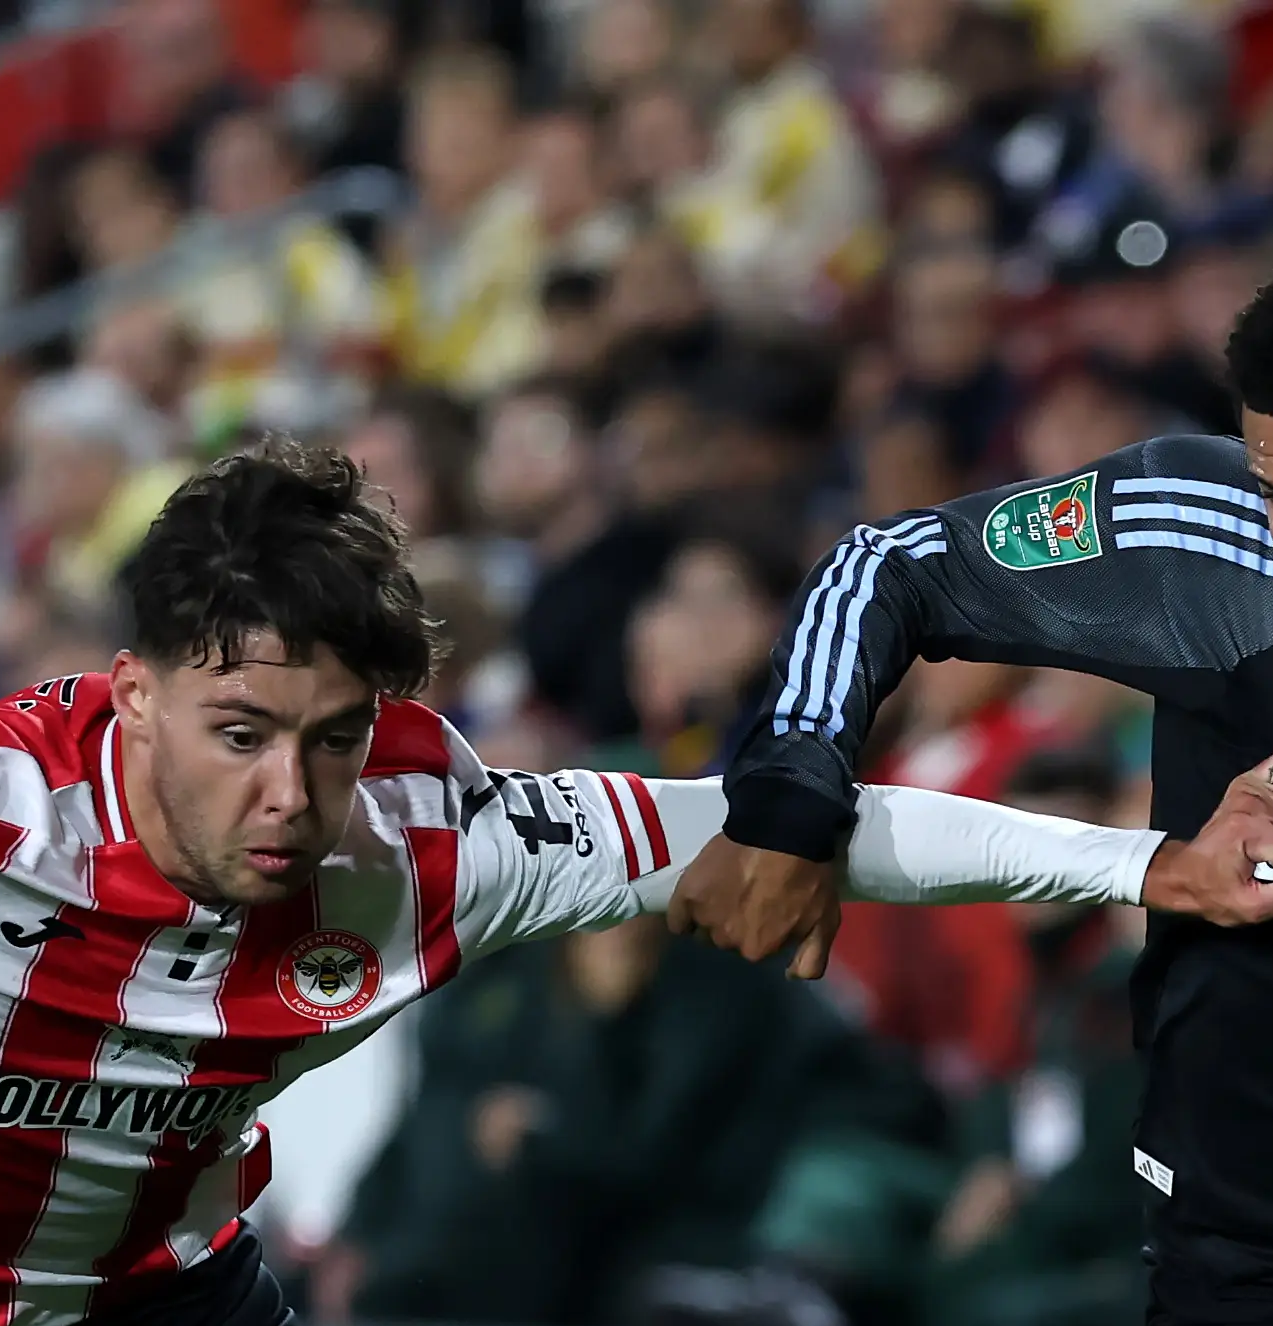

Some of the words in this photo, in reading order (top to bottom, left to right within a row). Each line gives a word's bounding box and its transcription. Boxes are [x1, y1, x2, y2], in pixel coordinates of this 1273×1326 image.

[1026, 512, 1042, 541] Cup
[1038, 492, 1061, 557] Carabao
[995, 530, 1006, 550] EFL
[291, 997, 345, 1017] FOOTBALL
[346, 992, 370, 1012] CLUB
